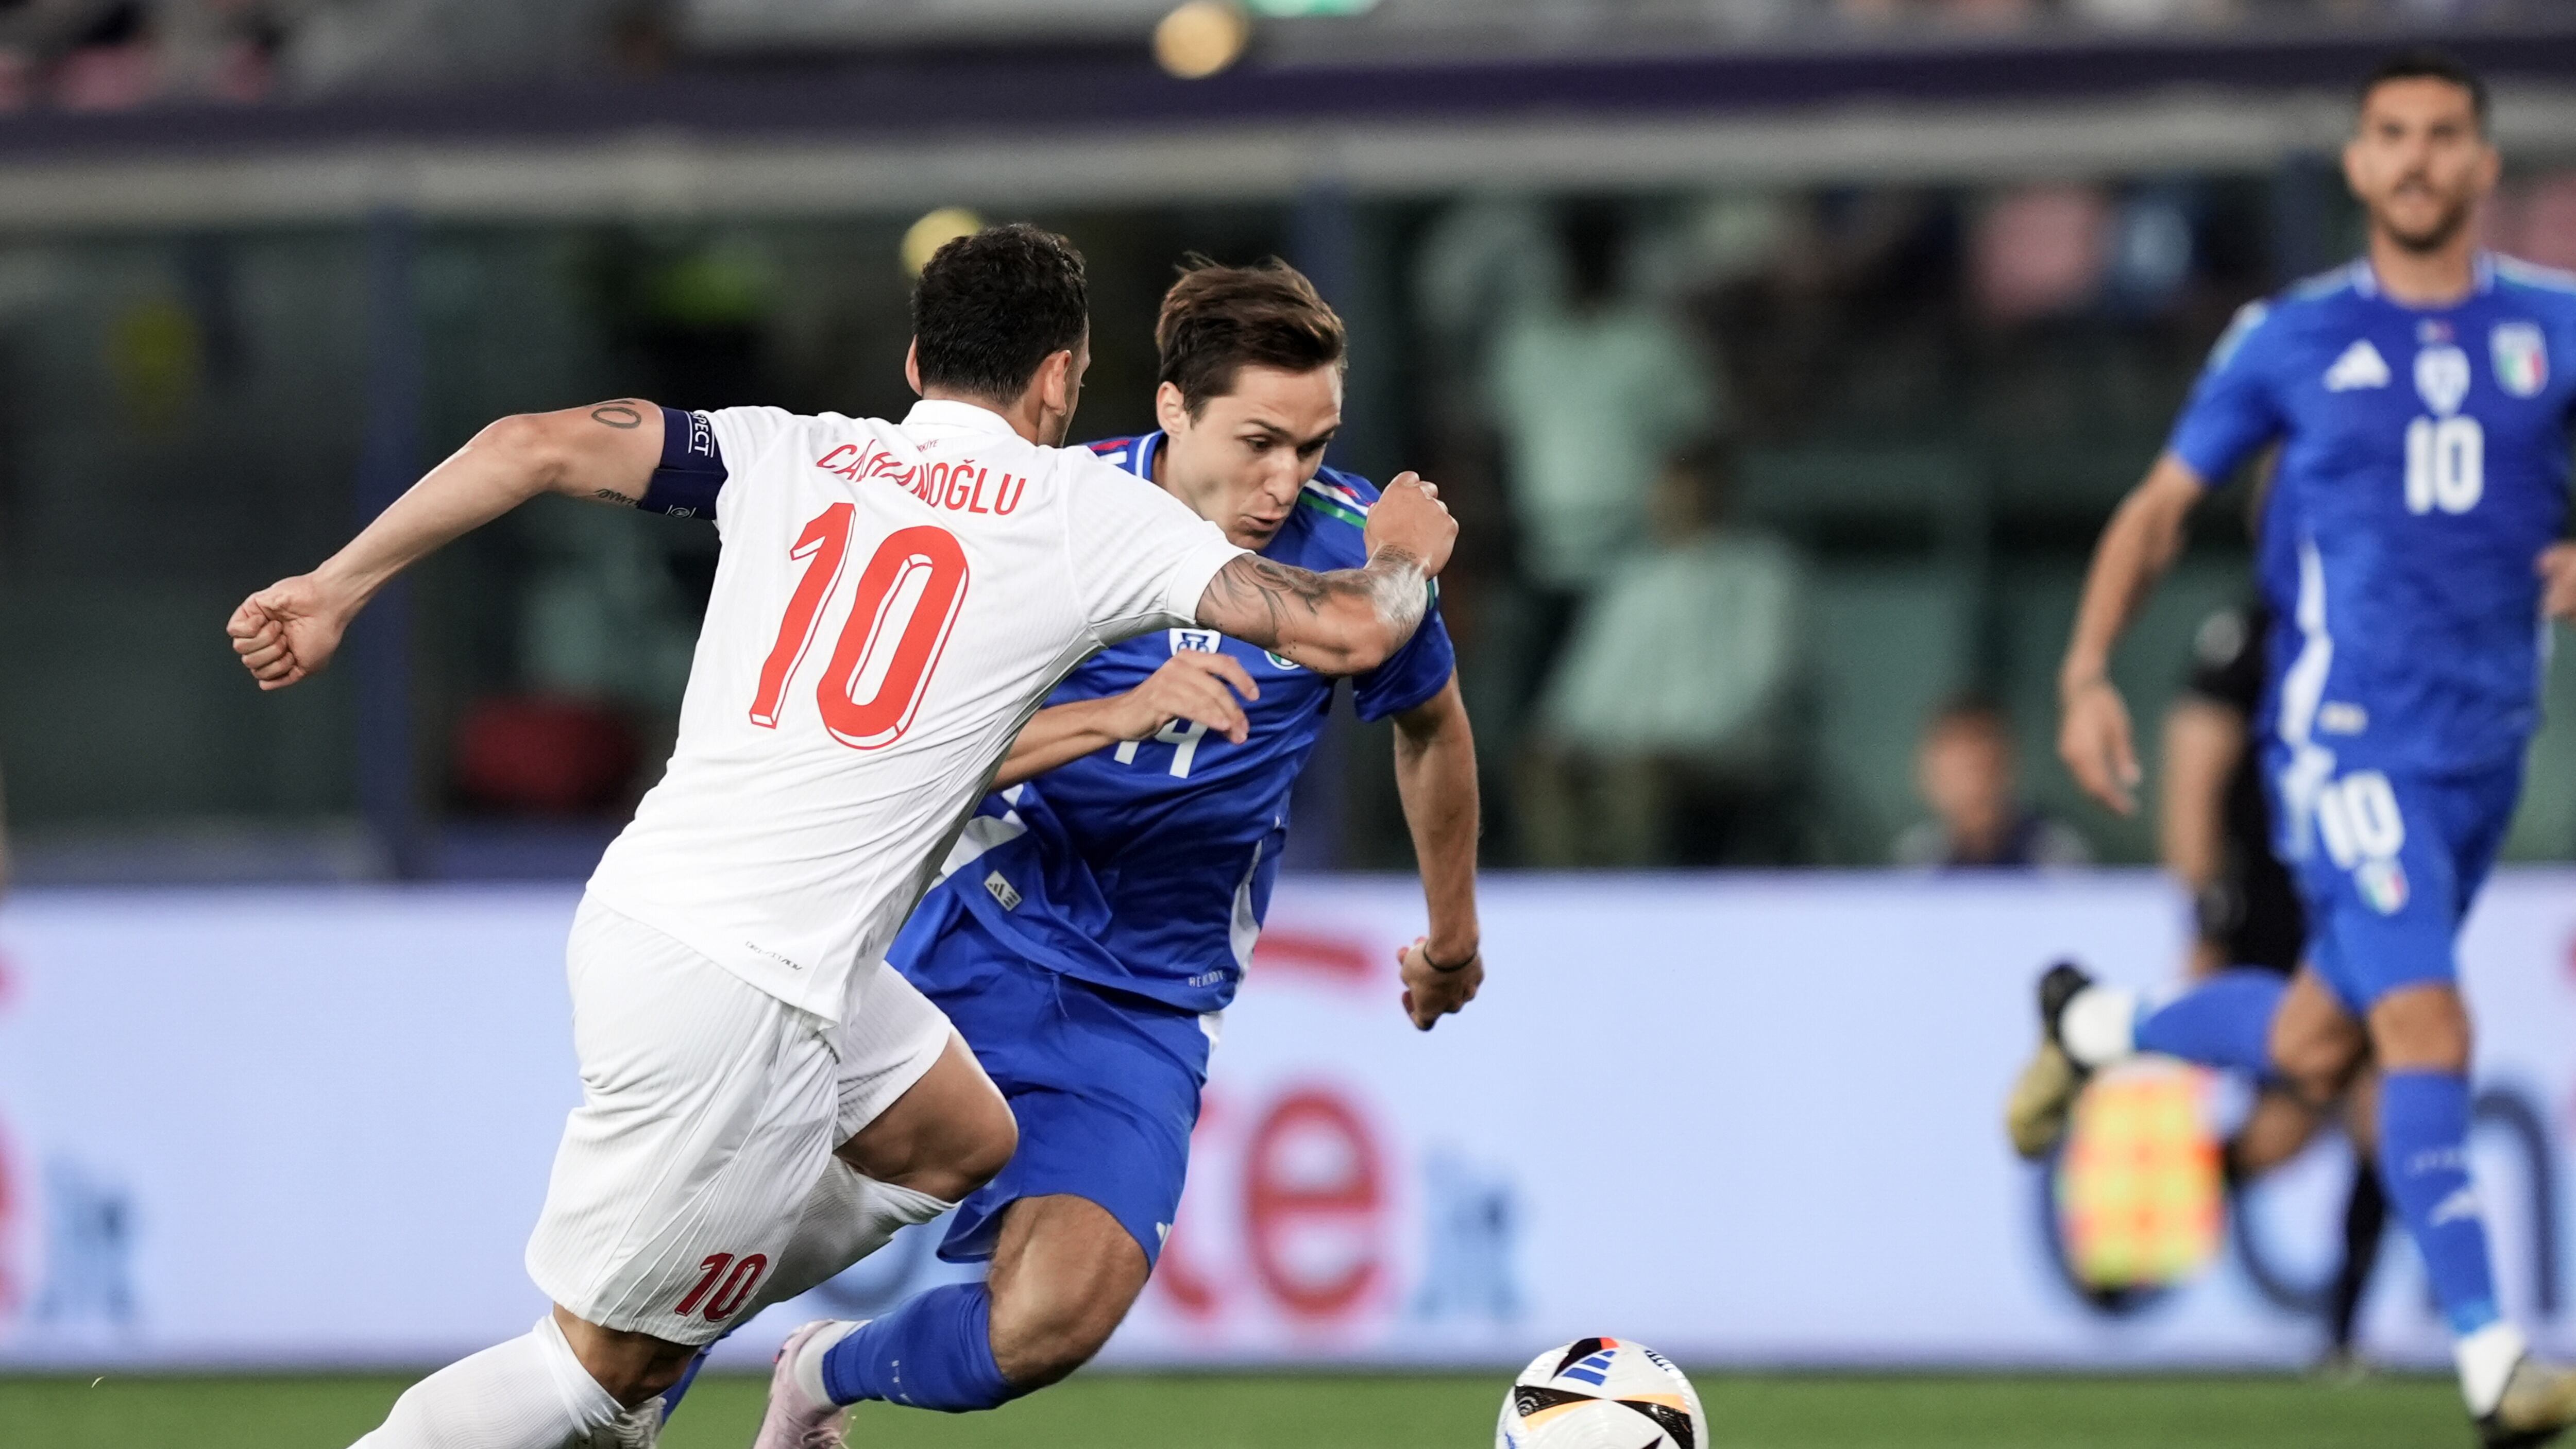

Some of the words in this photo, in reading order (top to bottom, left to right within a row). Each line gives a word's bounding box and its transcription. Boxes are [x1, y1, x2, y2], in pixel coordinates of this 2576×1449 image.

[2405, 416, 2484, 515] 10
[749, 502, 969, 751] 10
[2319, 771, 2408, 868] 10
[674, 1252, 767, 1322] 10
